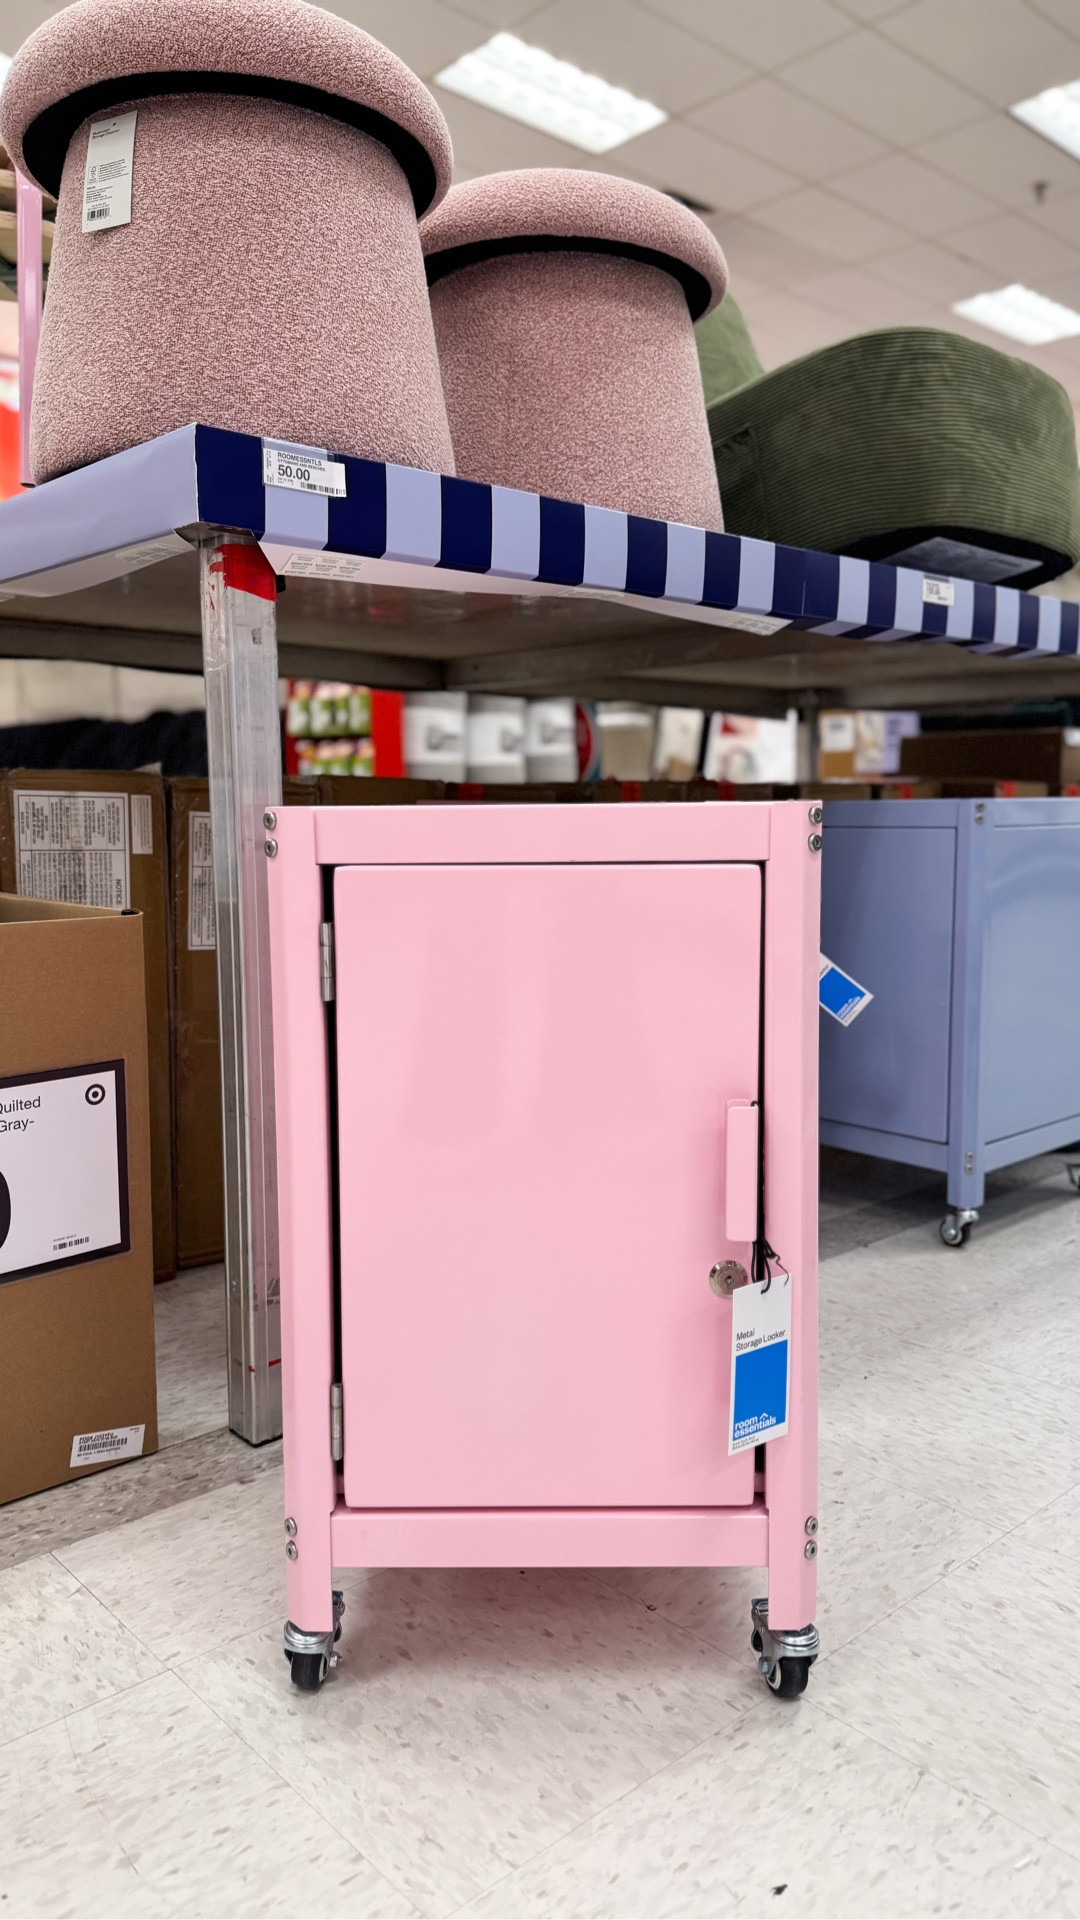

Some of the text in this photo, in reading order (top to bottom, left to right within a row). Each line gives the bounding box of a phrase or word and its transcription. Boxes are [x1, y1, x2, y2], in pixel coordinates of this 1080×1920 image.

[277, 452, 322, 467] ROOMESSNTLS
[277, 464, 311, 481] 50.00
[736, 1327, 756, 1341] Metal
[736, 1329, 786, 1352] Storage Locker
[734, 1415, 758, 1431] room
[734, 1415, 777, 1438] essentials
